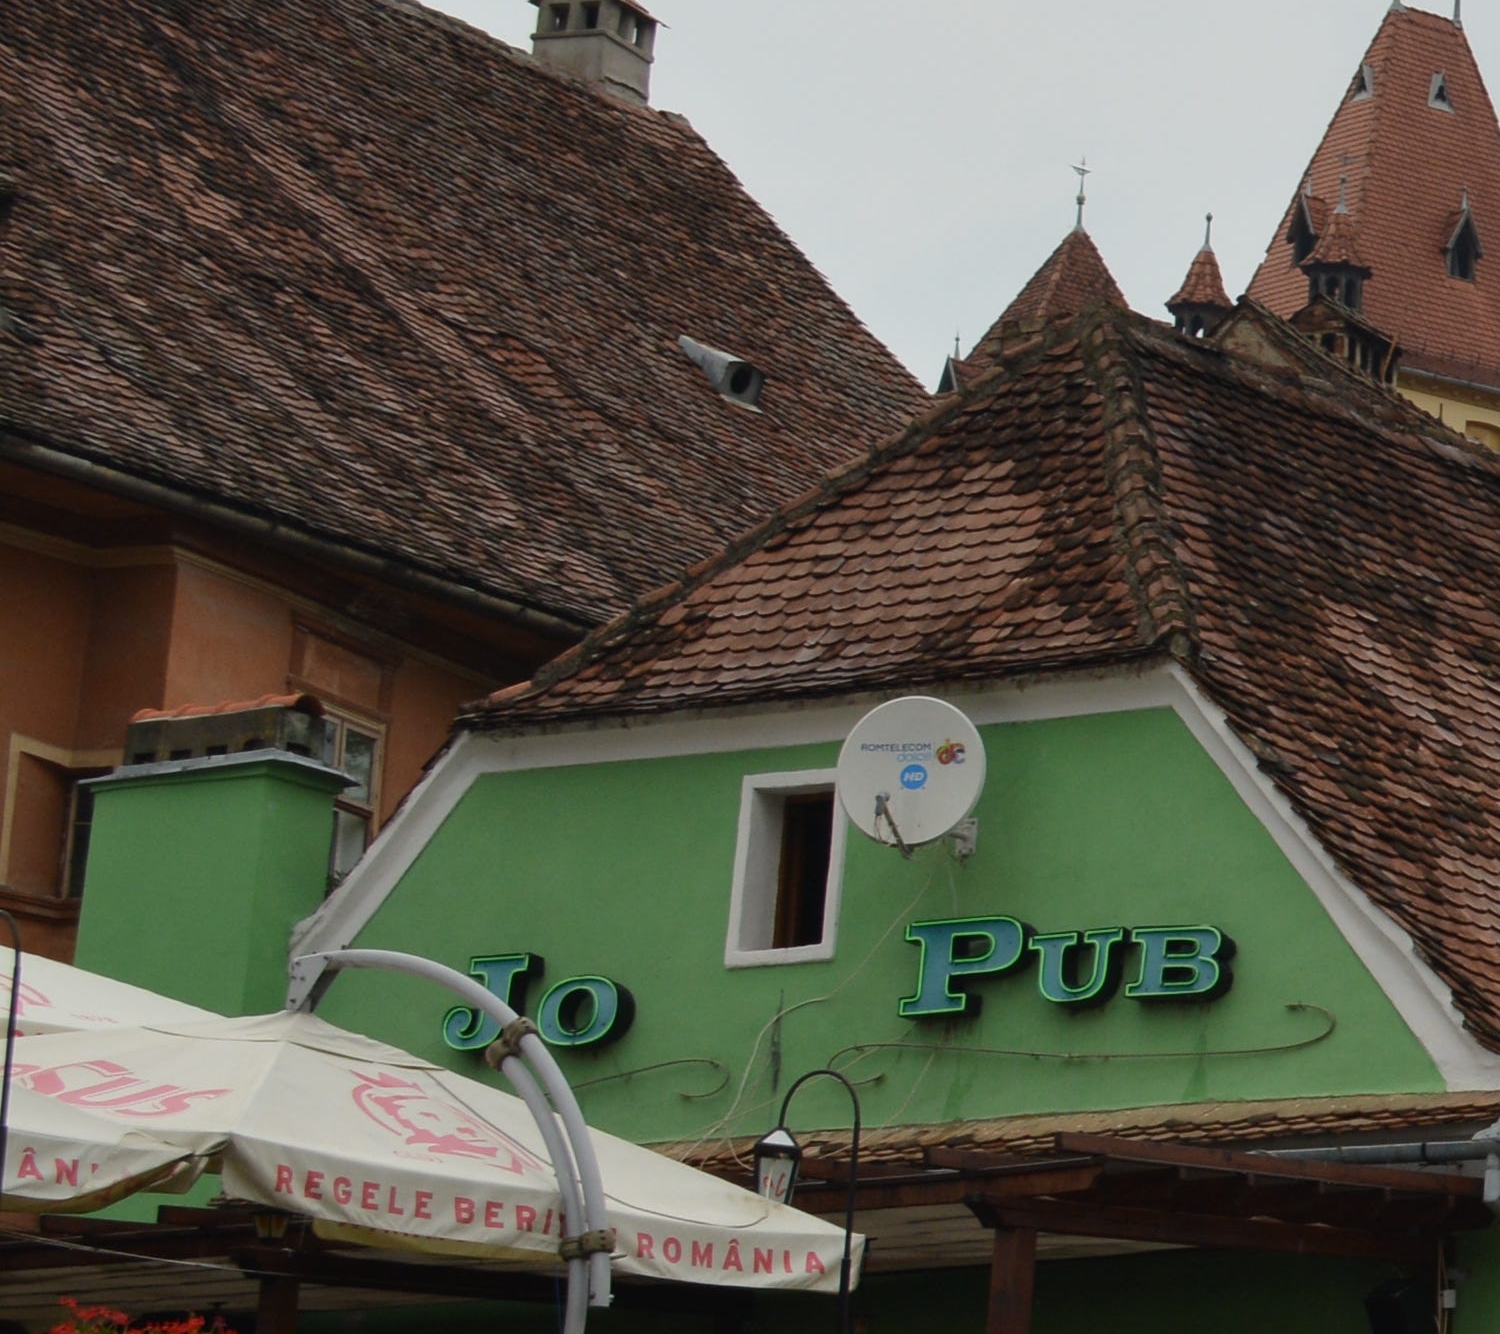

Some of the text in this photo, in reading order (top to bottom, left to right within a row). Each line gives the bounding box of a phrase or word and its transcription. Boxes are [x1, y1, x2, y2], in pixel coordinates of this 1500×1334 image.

[861, 743, 931, 752] ROMTELECOM
[443, 915, 1224, 1051] Jo PUB
[274, 1164, 433, 1220] REGELE
[636, 1232, 826, 1275] ROMÂNIA
